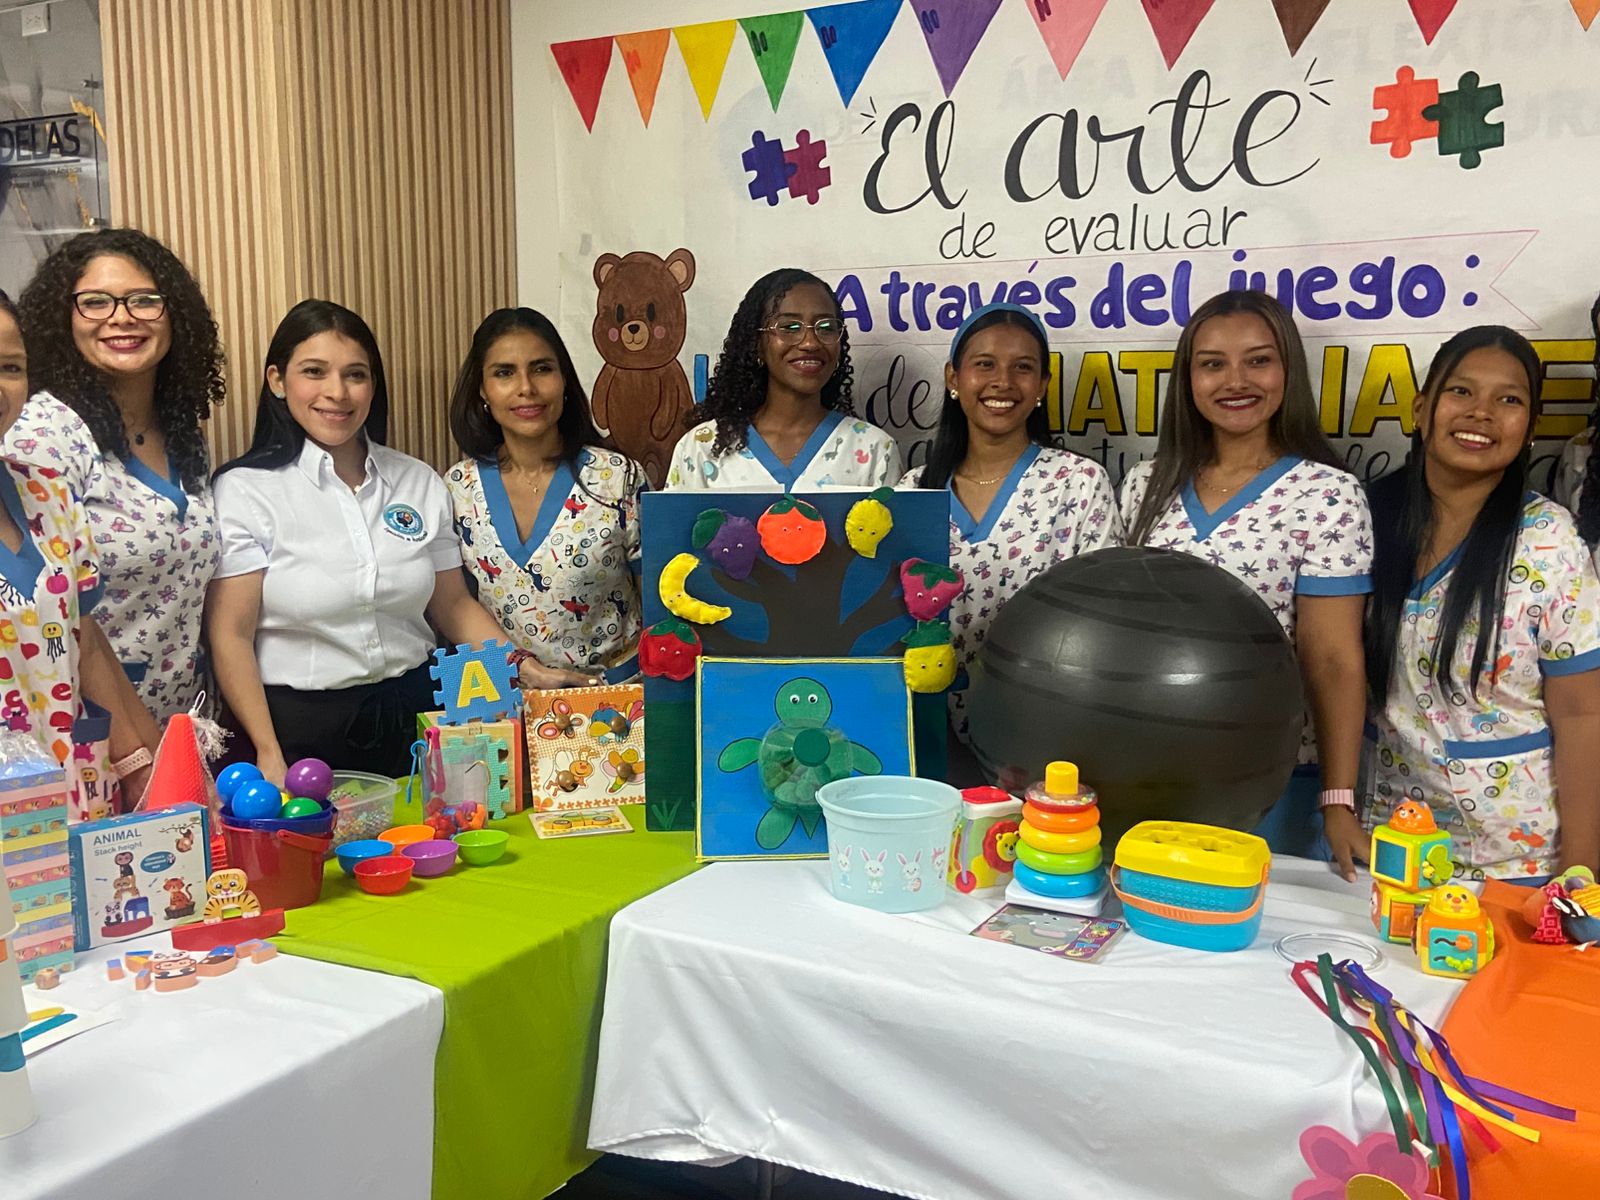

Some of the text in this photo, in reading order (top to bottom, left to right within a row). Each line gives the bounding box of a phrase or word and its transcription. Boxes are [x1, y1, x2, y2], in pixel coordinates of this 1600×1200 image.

[863, 69, 1320, 214] El arte
[939, 203, 1248, 260] de evaluar
[836, 274, 873, 332] A
[880, 260, 1077, 332] través
[1089, 259, 1193, 330] del
[866, 354, 940, 430] de
[456, 661, 501, 708] A
[93, 828, 142, 846] ANIMAL
[94, 841, 143, 857] Stack height
